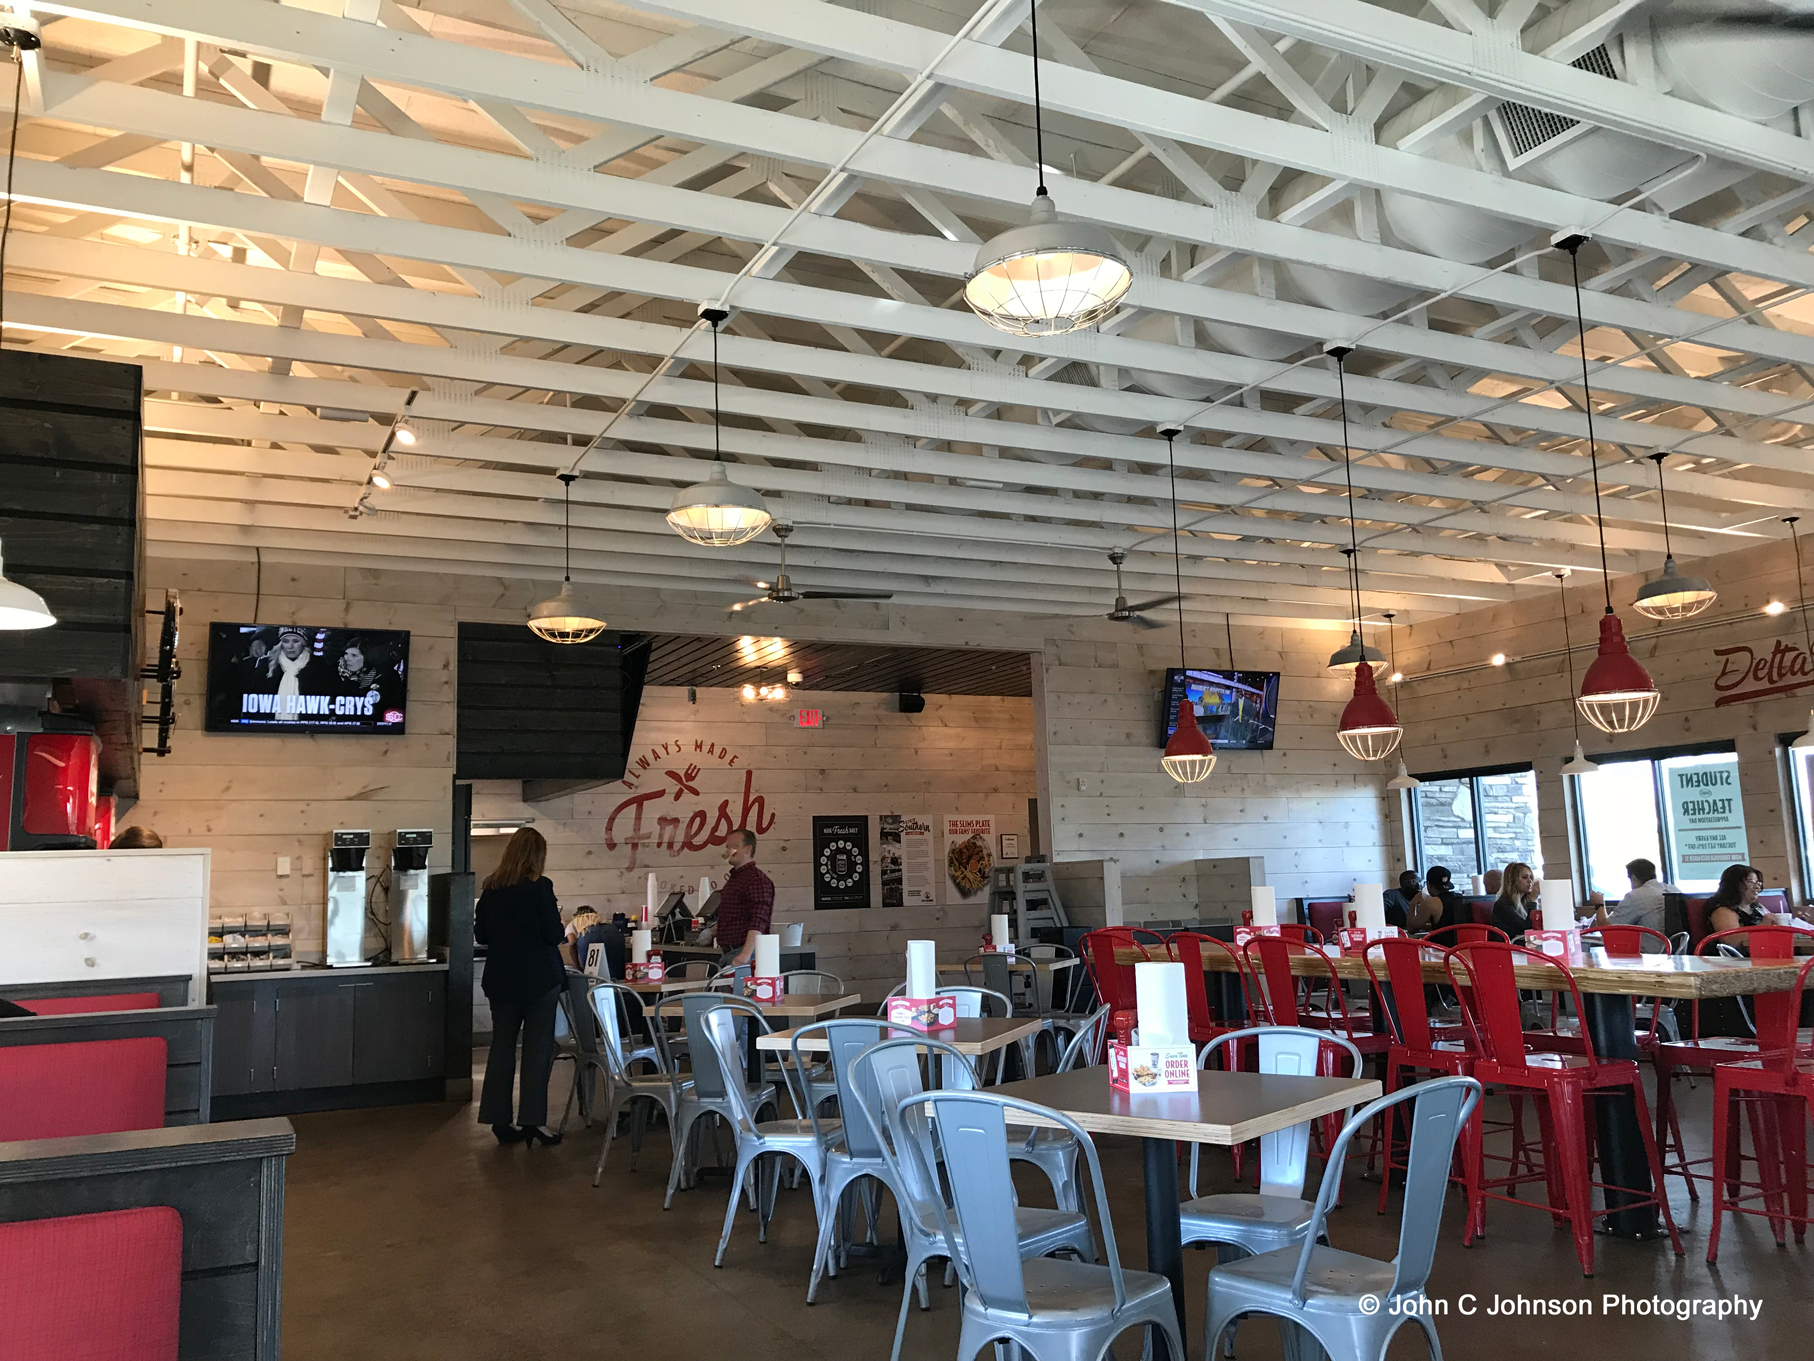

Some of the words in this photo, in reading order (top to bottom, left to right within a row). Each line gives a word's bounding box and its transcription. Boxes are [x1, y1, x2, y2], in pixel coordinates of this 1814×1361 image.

[242, 693, 282, 714] IOWA
[286, 695, 374, 716] HAWK-CRYS
[799, 709, 819, 727] EXIT
[621, 739, 682, 790] ALWAYS
[694, 739, 739, 767] MADE
[605, 769, 776, 873] Fresh
[898, 820, 931, 833] Southern
[948, 820, 959, 828] THE
[975, 820, 991, 828] PLATE
[587, 948, 600, 968] 81
[1165, 1059, 1189, 1069] ORDER
[1164, 1069, 1190, 1079] ONLINE
